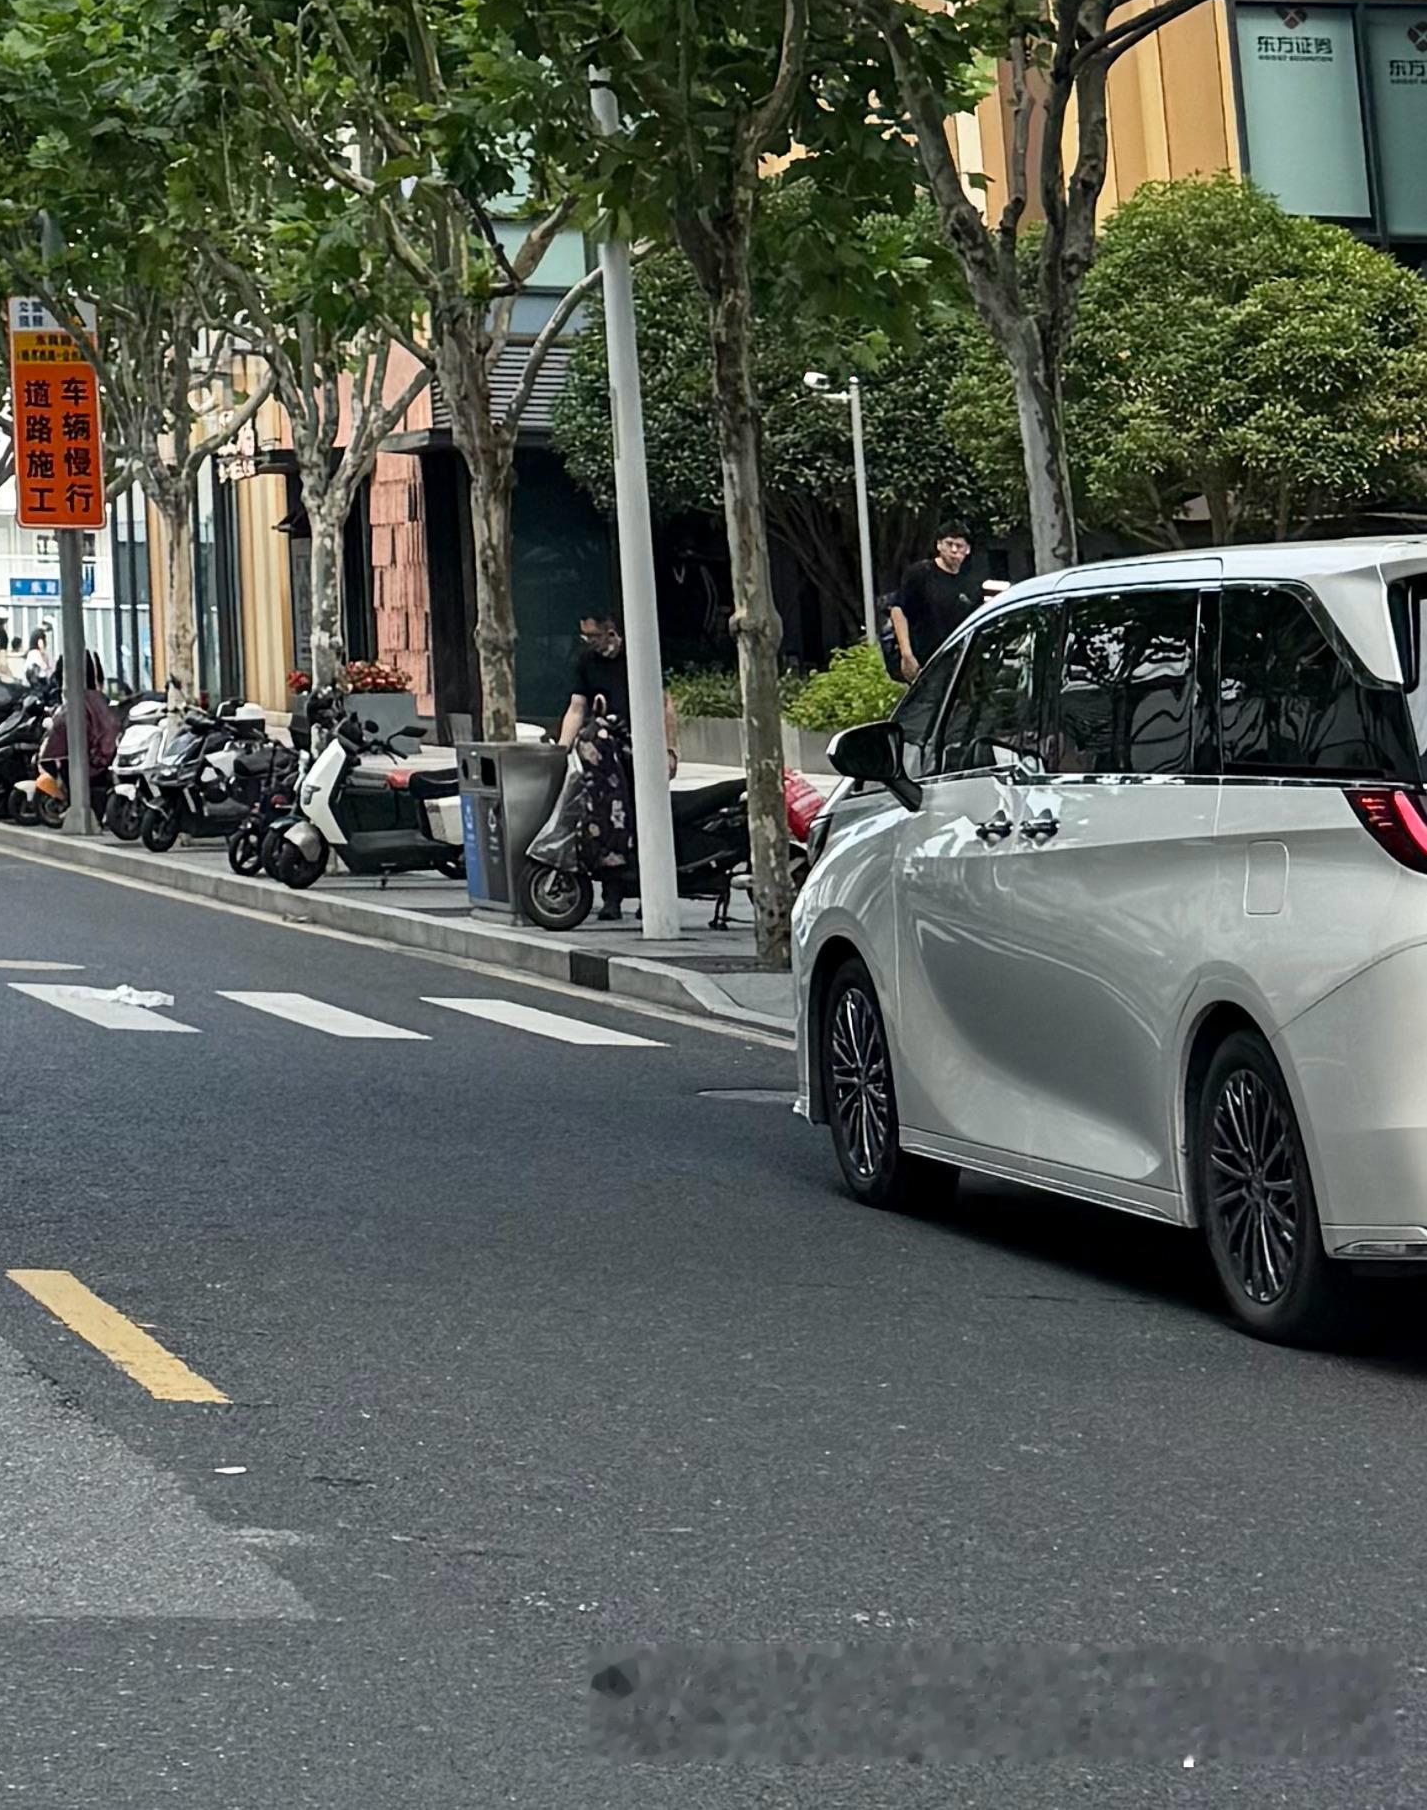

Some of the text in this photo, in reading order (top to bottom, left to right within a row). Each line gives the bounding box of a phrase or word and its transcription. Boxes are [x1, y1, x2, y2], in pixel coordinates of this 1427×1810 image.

[1258, 36, 1333, 54] 东方证券
[24, 380, 56, 512] 道路施工
[60, 377, 94, 513] 车辆慢行
